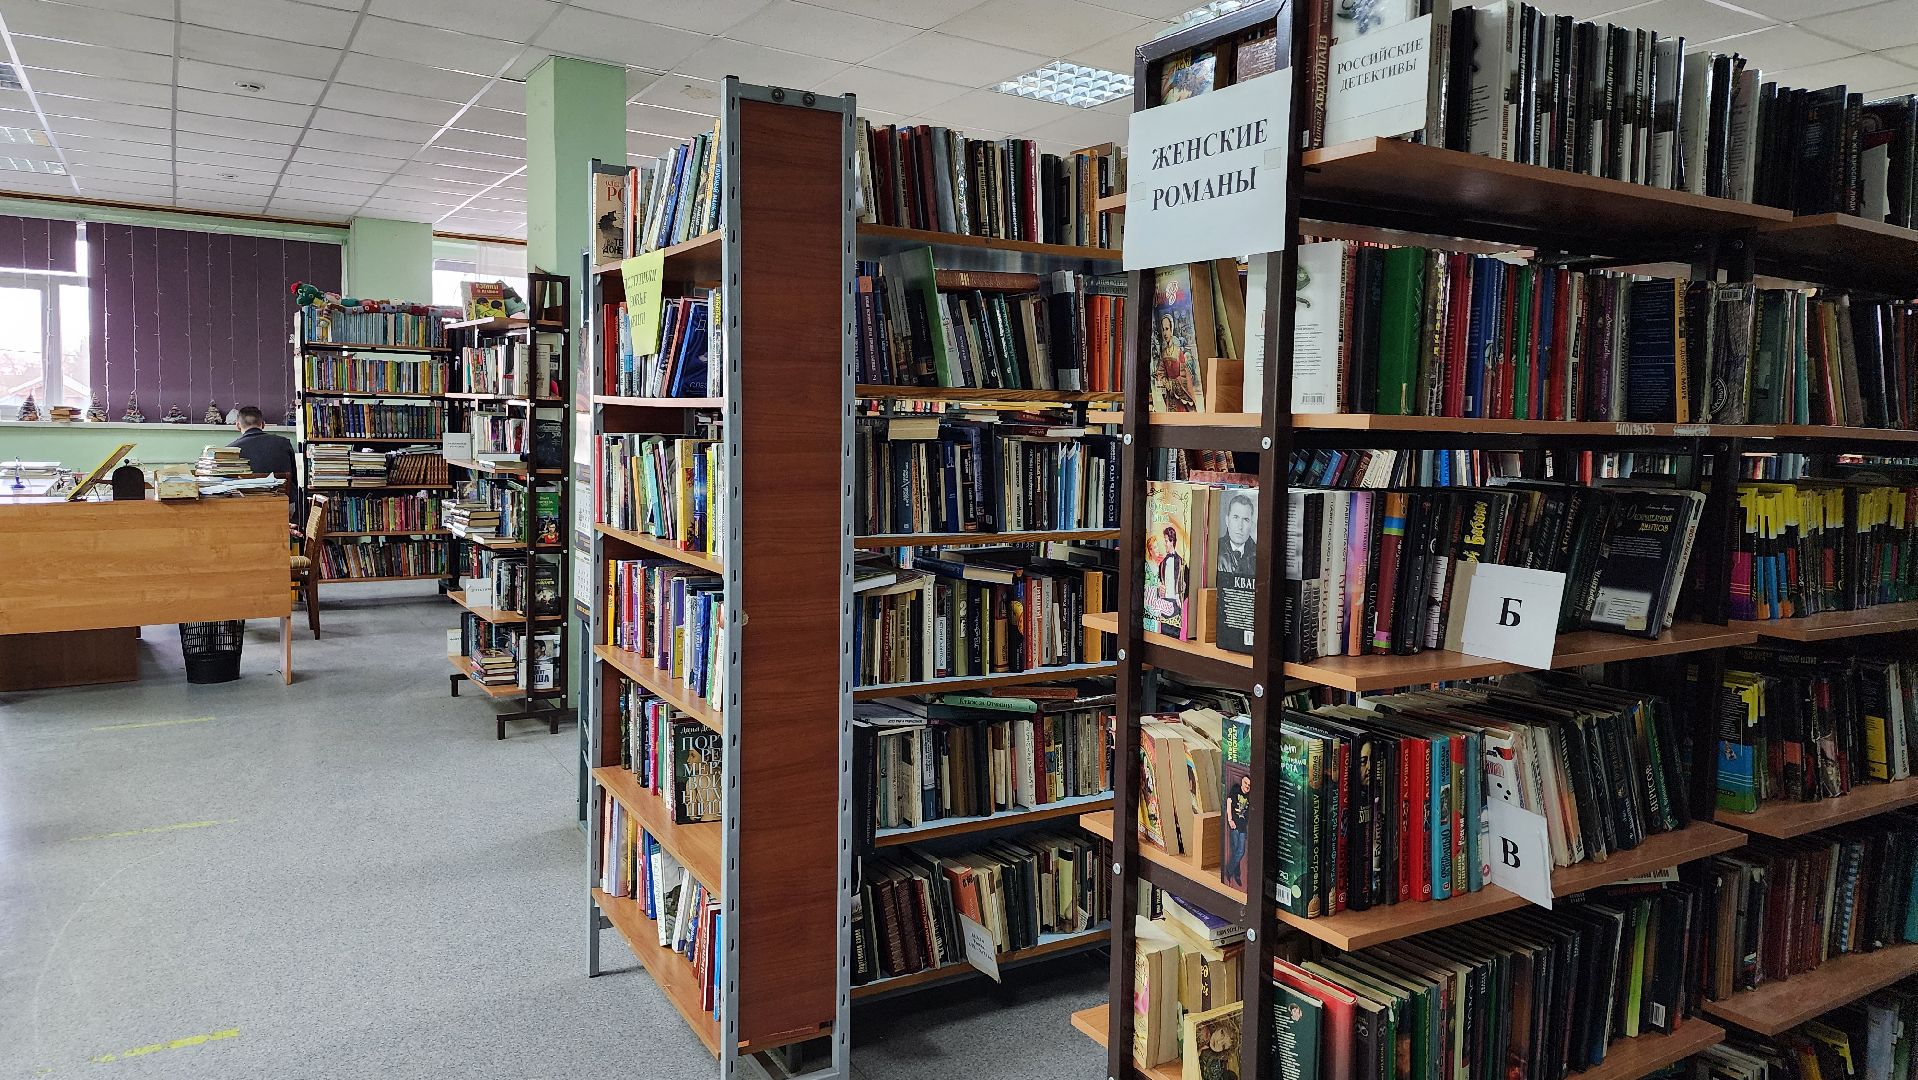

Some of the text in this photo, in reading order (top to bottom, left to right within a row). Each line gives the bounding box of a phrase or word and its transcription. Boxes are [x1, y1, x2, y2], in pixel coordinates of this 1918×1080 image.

[1315, 35, 1328, 111] АБДУЛЛАЕВ
[1337, 37, 1424, 75] РОССИЙСКИЕ
[1339, 58, 1417, 94] ДЕТЕКТИВЫ
[1151, 118, 1269, 171] ЖЕНСКИЕ
[1151, 166, 1257, 211] РОМАНЫ
[1496, 597, 1523, 628] Б
[682, 735, 723, 751] ПОР
[701, 748, 723, 762] РЕ
[1311, 794, 1320, 892] ЛЕТАЮЩИЕ ОСТРОВА
[1500, 835, 1521, 869] В
